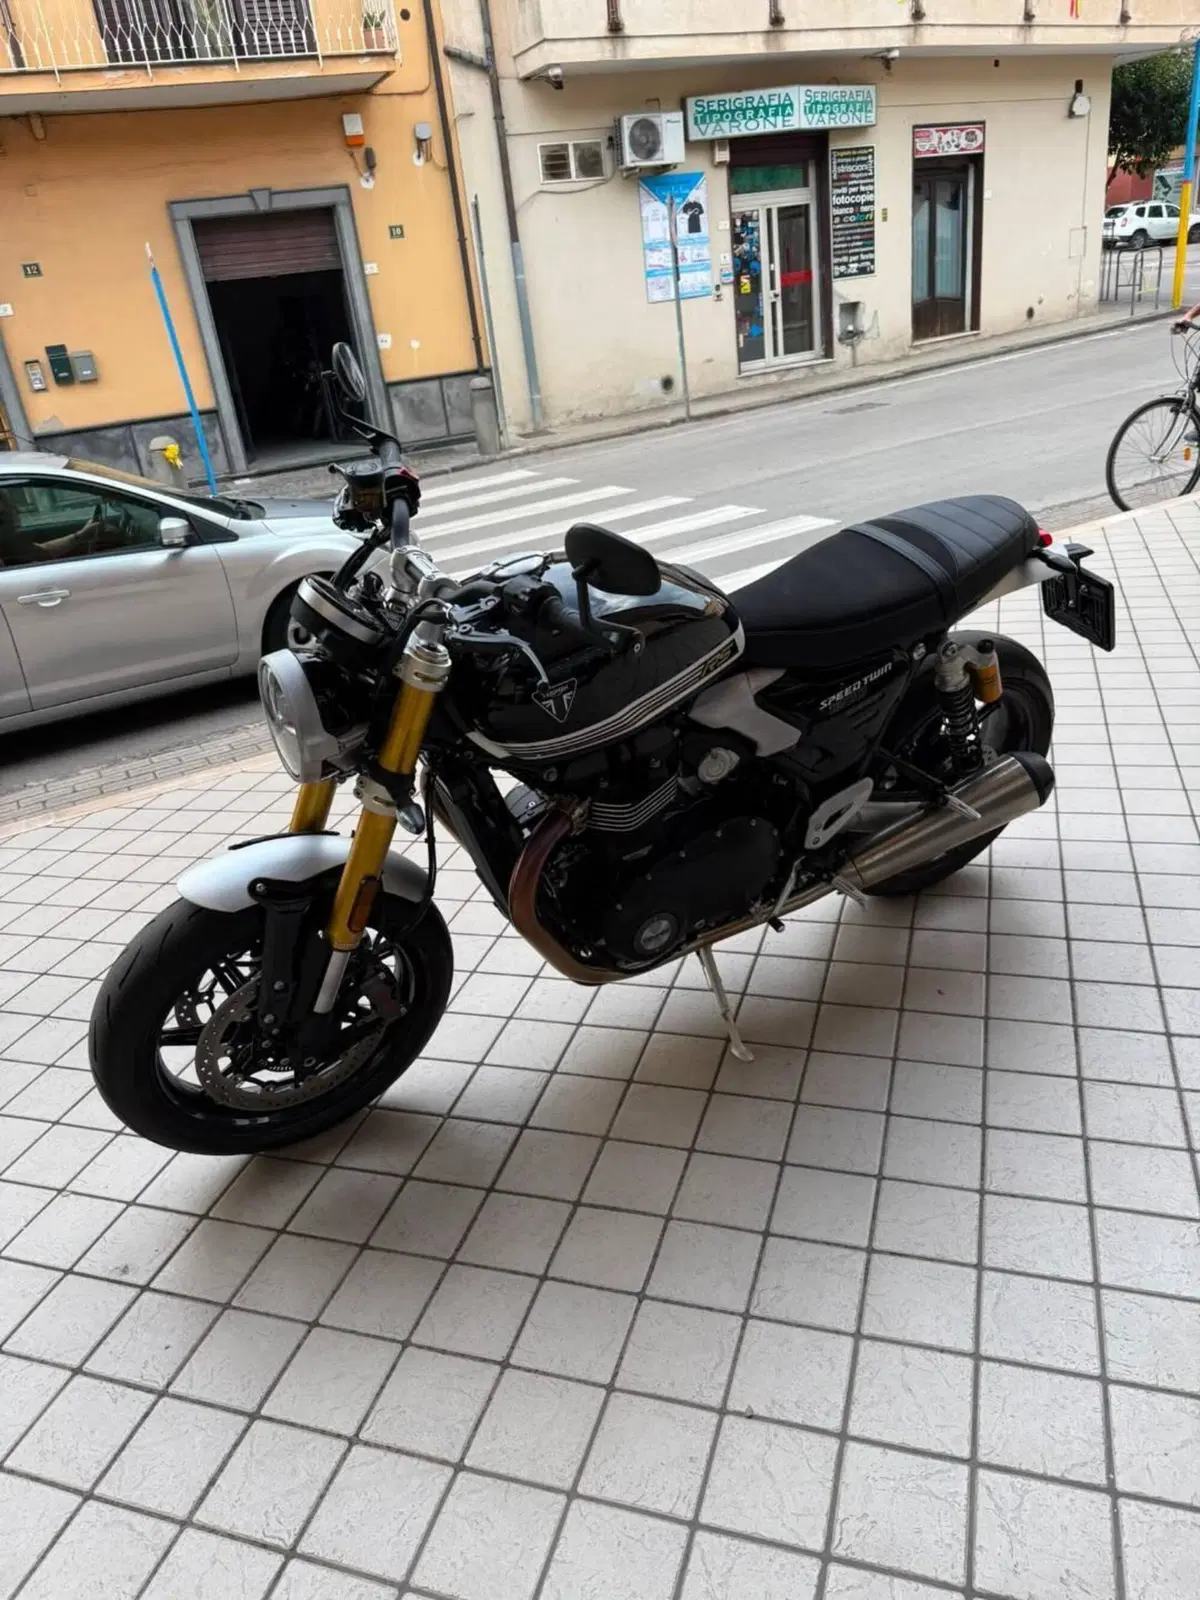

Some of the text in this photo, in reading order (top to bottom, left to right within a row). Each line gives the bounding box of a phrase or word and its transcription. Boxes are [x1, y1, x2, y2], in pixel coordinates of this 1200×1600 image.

[695, 105, 793, 124] TIPOGRAFIA
[805, 103, 873, 114] TIPOGRAFIA
[805, 112, 873, 125] VARONE
[697, 115, 795, 136] VARONE
[832, 192, 873, 205] fotocopie
[843, 211, 873, 222] colori
[25, 264, 39, 275] 12
[819, 680, 861, 711] SPEED
[862, 661, 892, 685] TWIN
